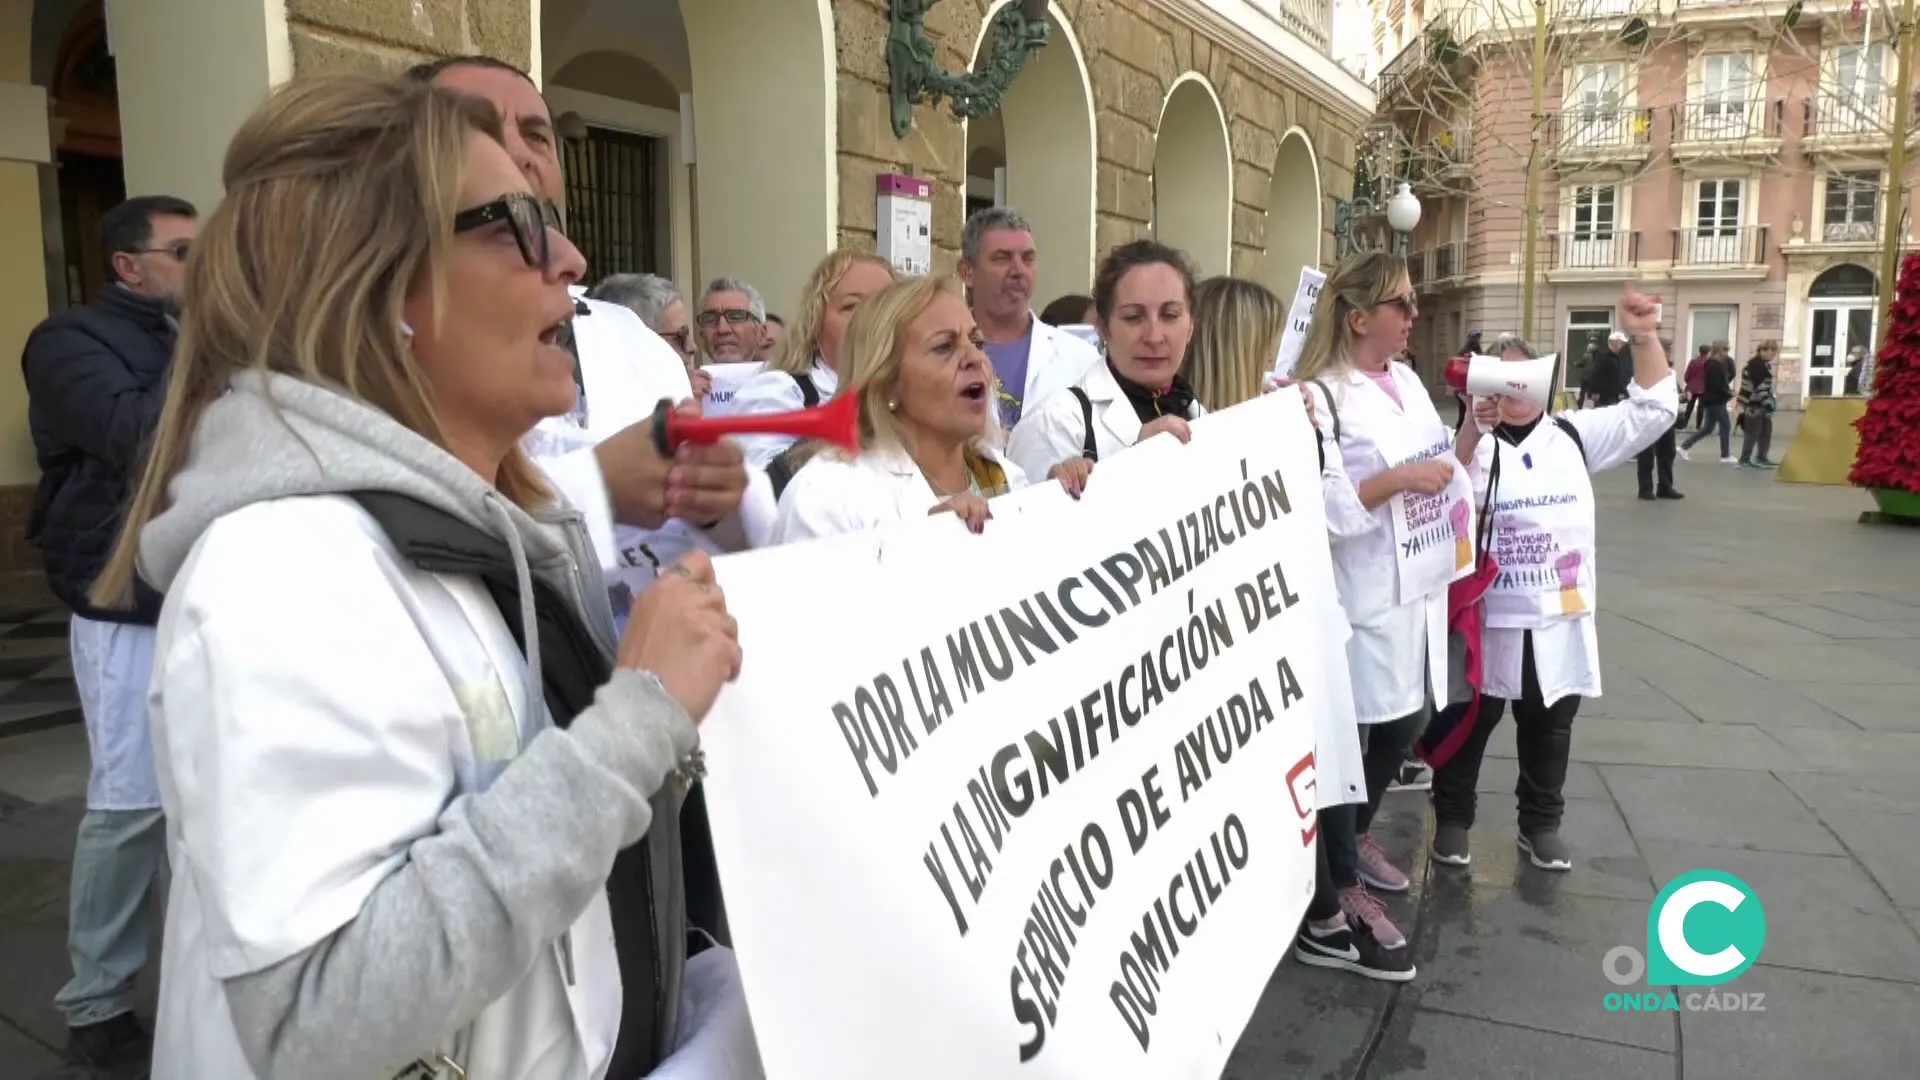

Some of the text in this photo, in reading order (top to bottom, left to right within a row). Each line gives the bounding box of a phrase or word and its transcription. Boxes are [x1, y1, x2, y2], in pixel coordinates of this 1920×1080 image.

[831, 457, 1292, 799] POR LA MUNICIPALIZACIÓN
[923, 561, 1300, 938] Y LA DIGNIFICACIÓN DEL
[1010, 656, 1304, 1064] SERVICIO DE AYUDA A
[1109, 813, 1249, 1054] DOMICILIO
